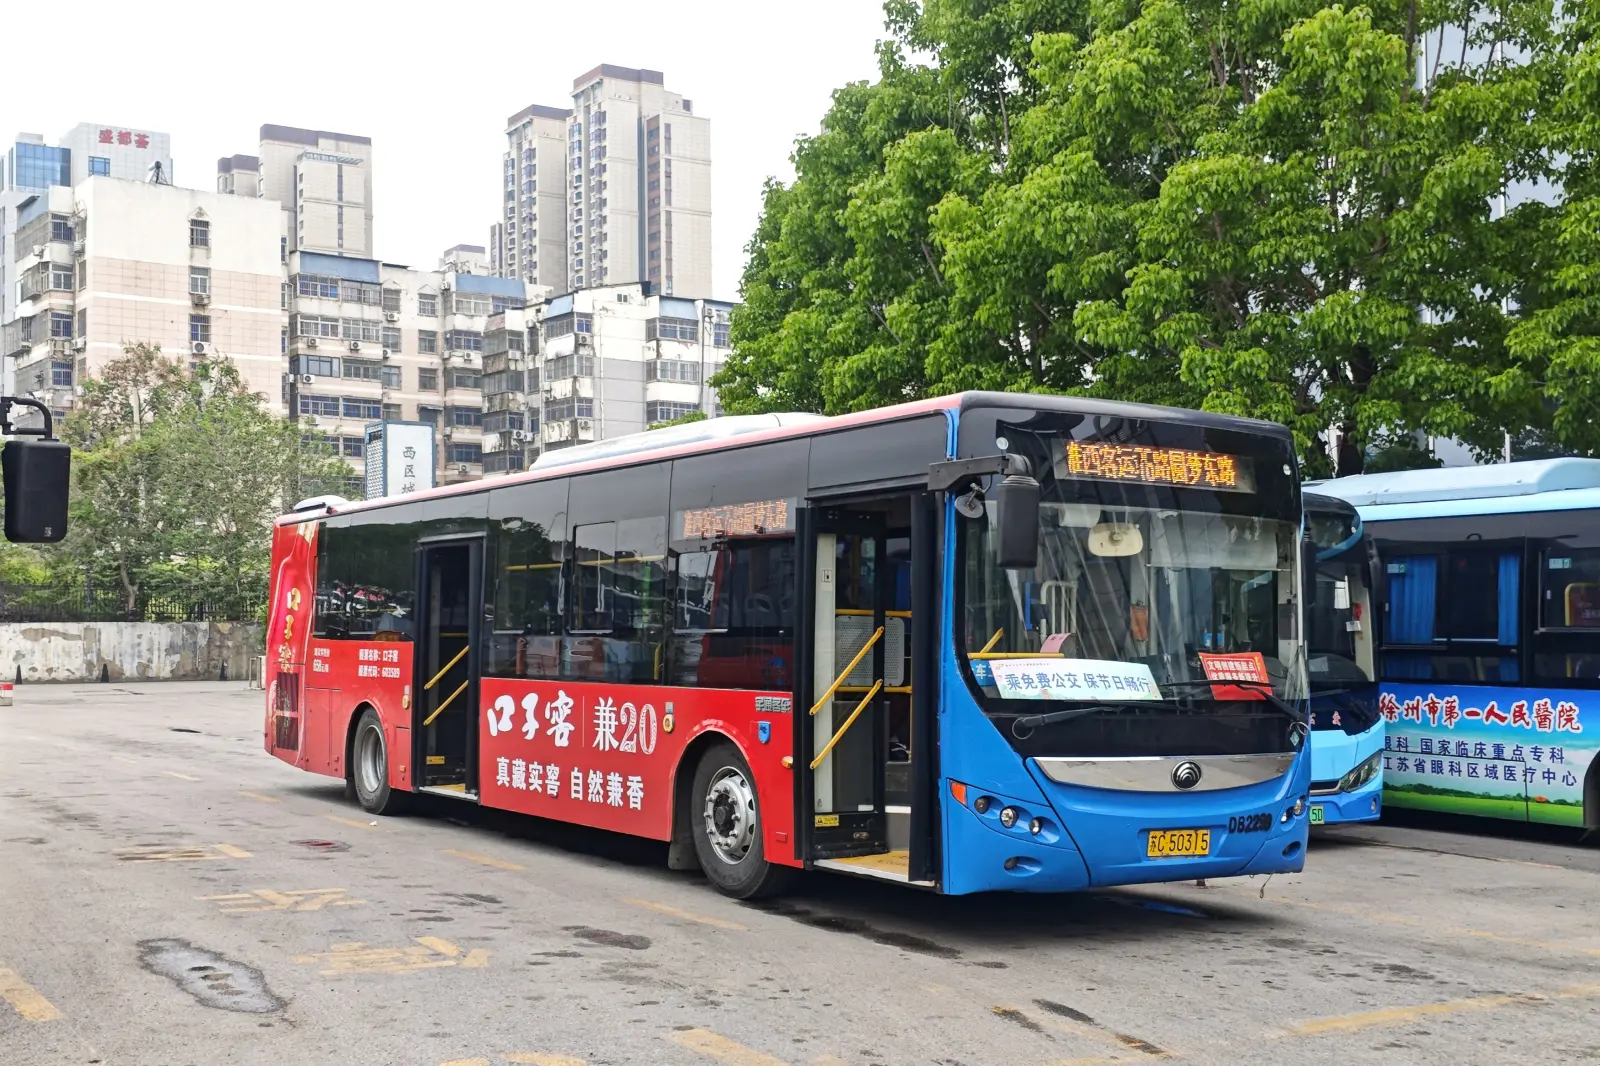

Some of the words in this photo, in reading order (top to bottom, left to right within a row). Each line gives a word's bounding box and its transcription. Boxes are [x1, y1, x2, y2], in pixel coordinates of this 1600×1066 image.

[1005, 672, 1081, 691] 乘免费公交
[1084, 672, 1151, 693] 保节日畅行
[487, 690, 575, 747] 口子窖
[1420, 738, 1565, 764] 国家临床重点专科
[496, 757, 561, 798] 真藏实窖
[570, 767, 644, 811] 自然兼香
